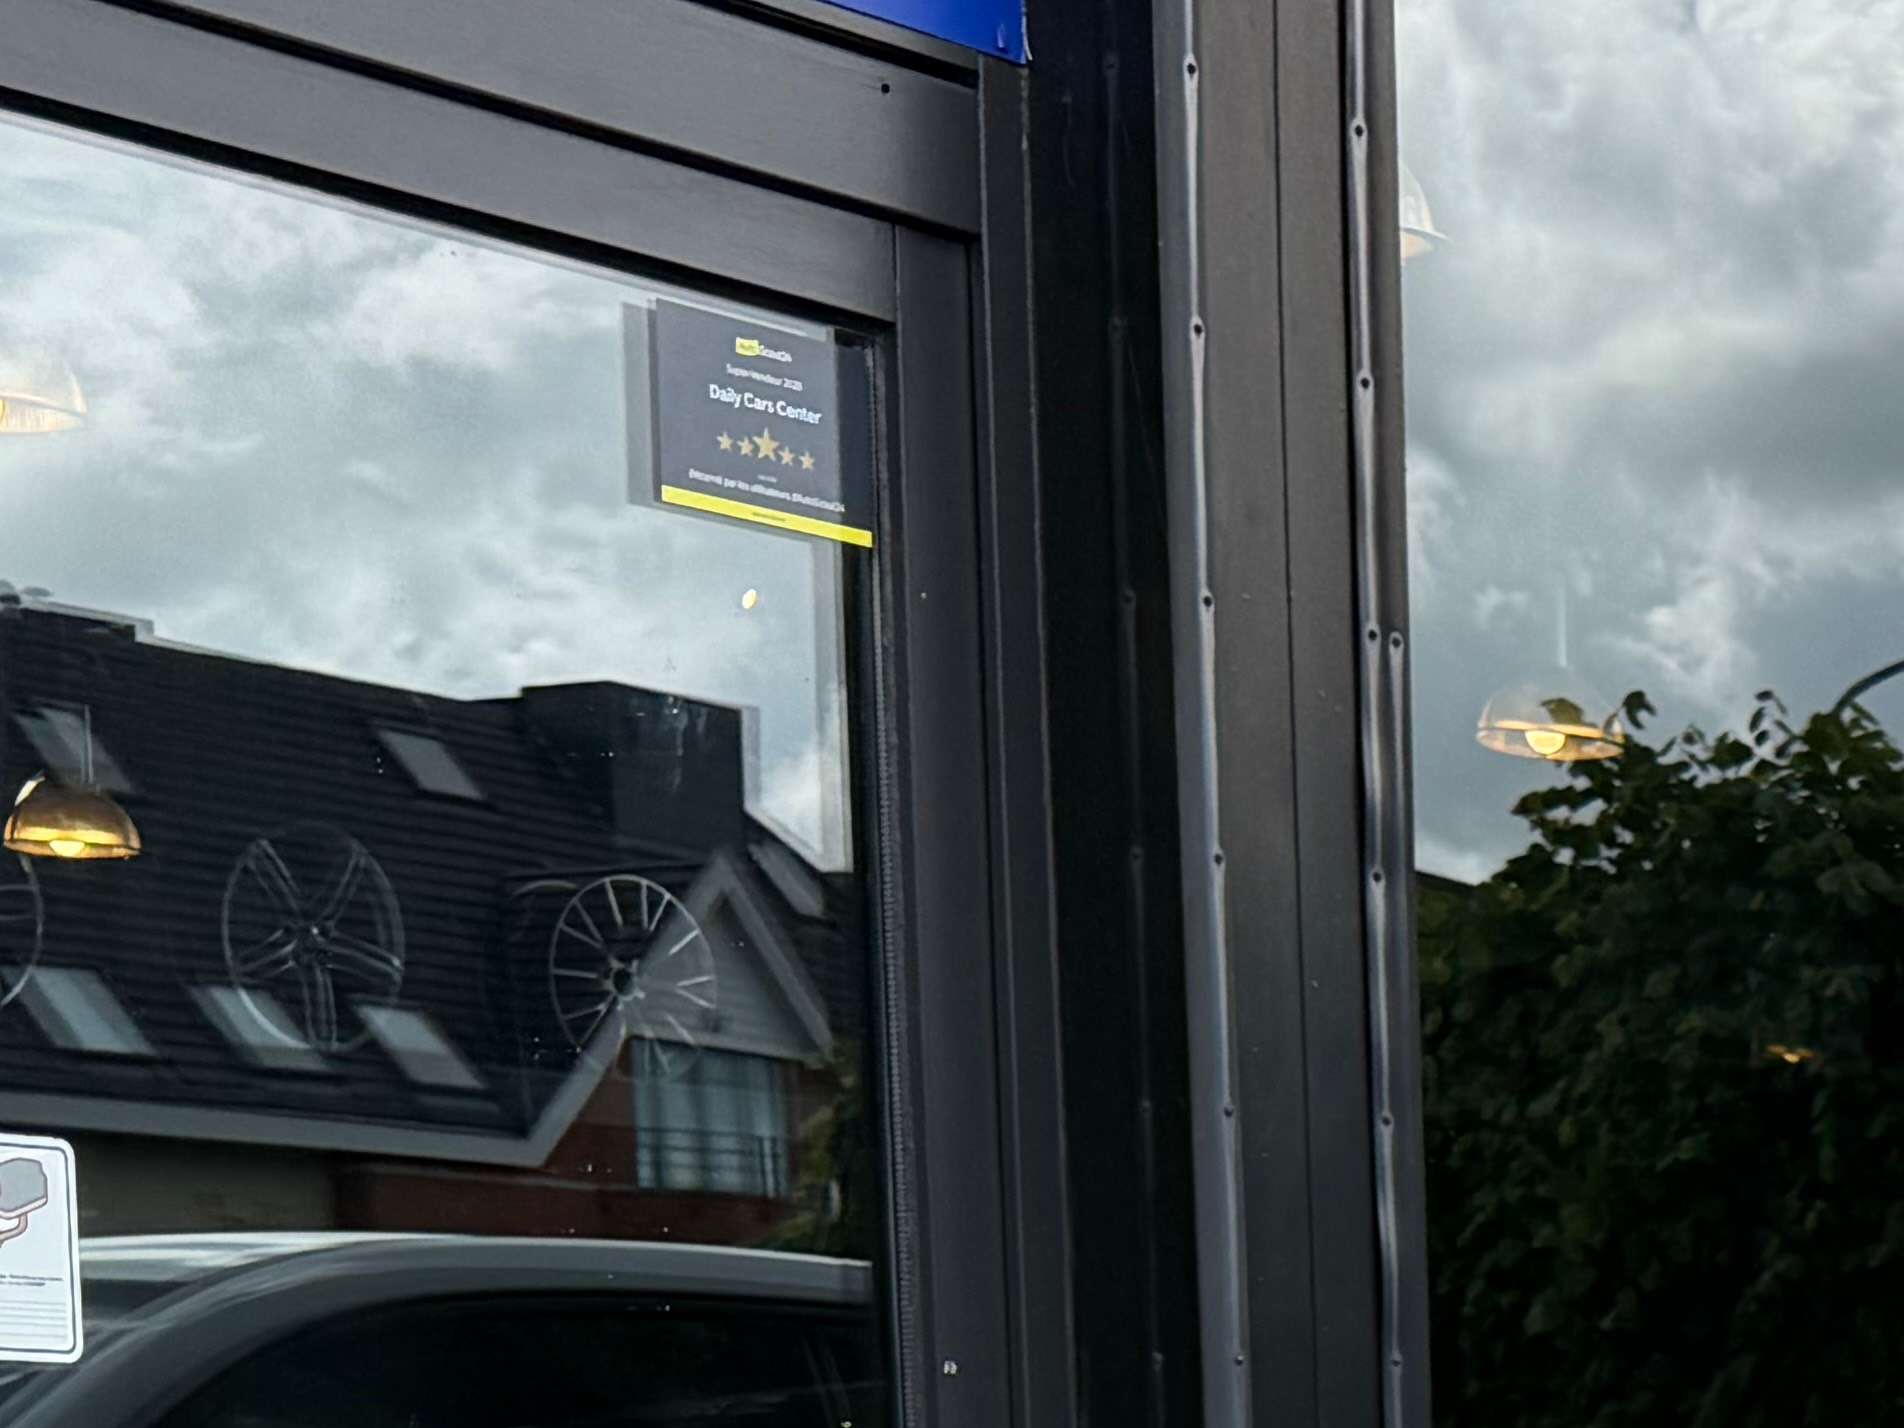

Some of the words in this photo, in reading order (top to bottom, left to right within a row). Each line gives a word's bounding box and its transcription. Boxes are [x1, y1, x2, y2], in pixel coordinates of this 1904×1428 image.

[709, 383, 742, 408] Daily
[743, 392, 774, 413] Cars
[776, 400, 822, 424] Center
